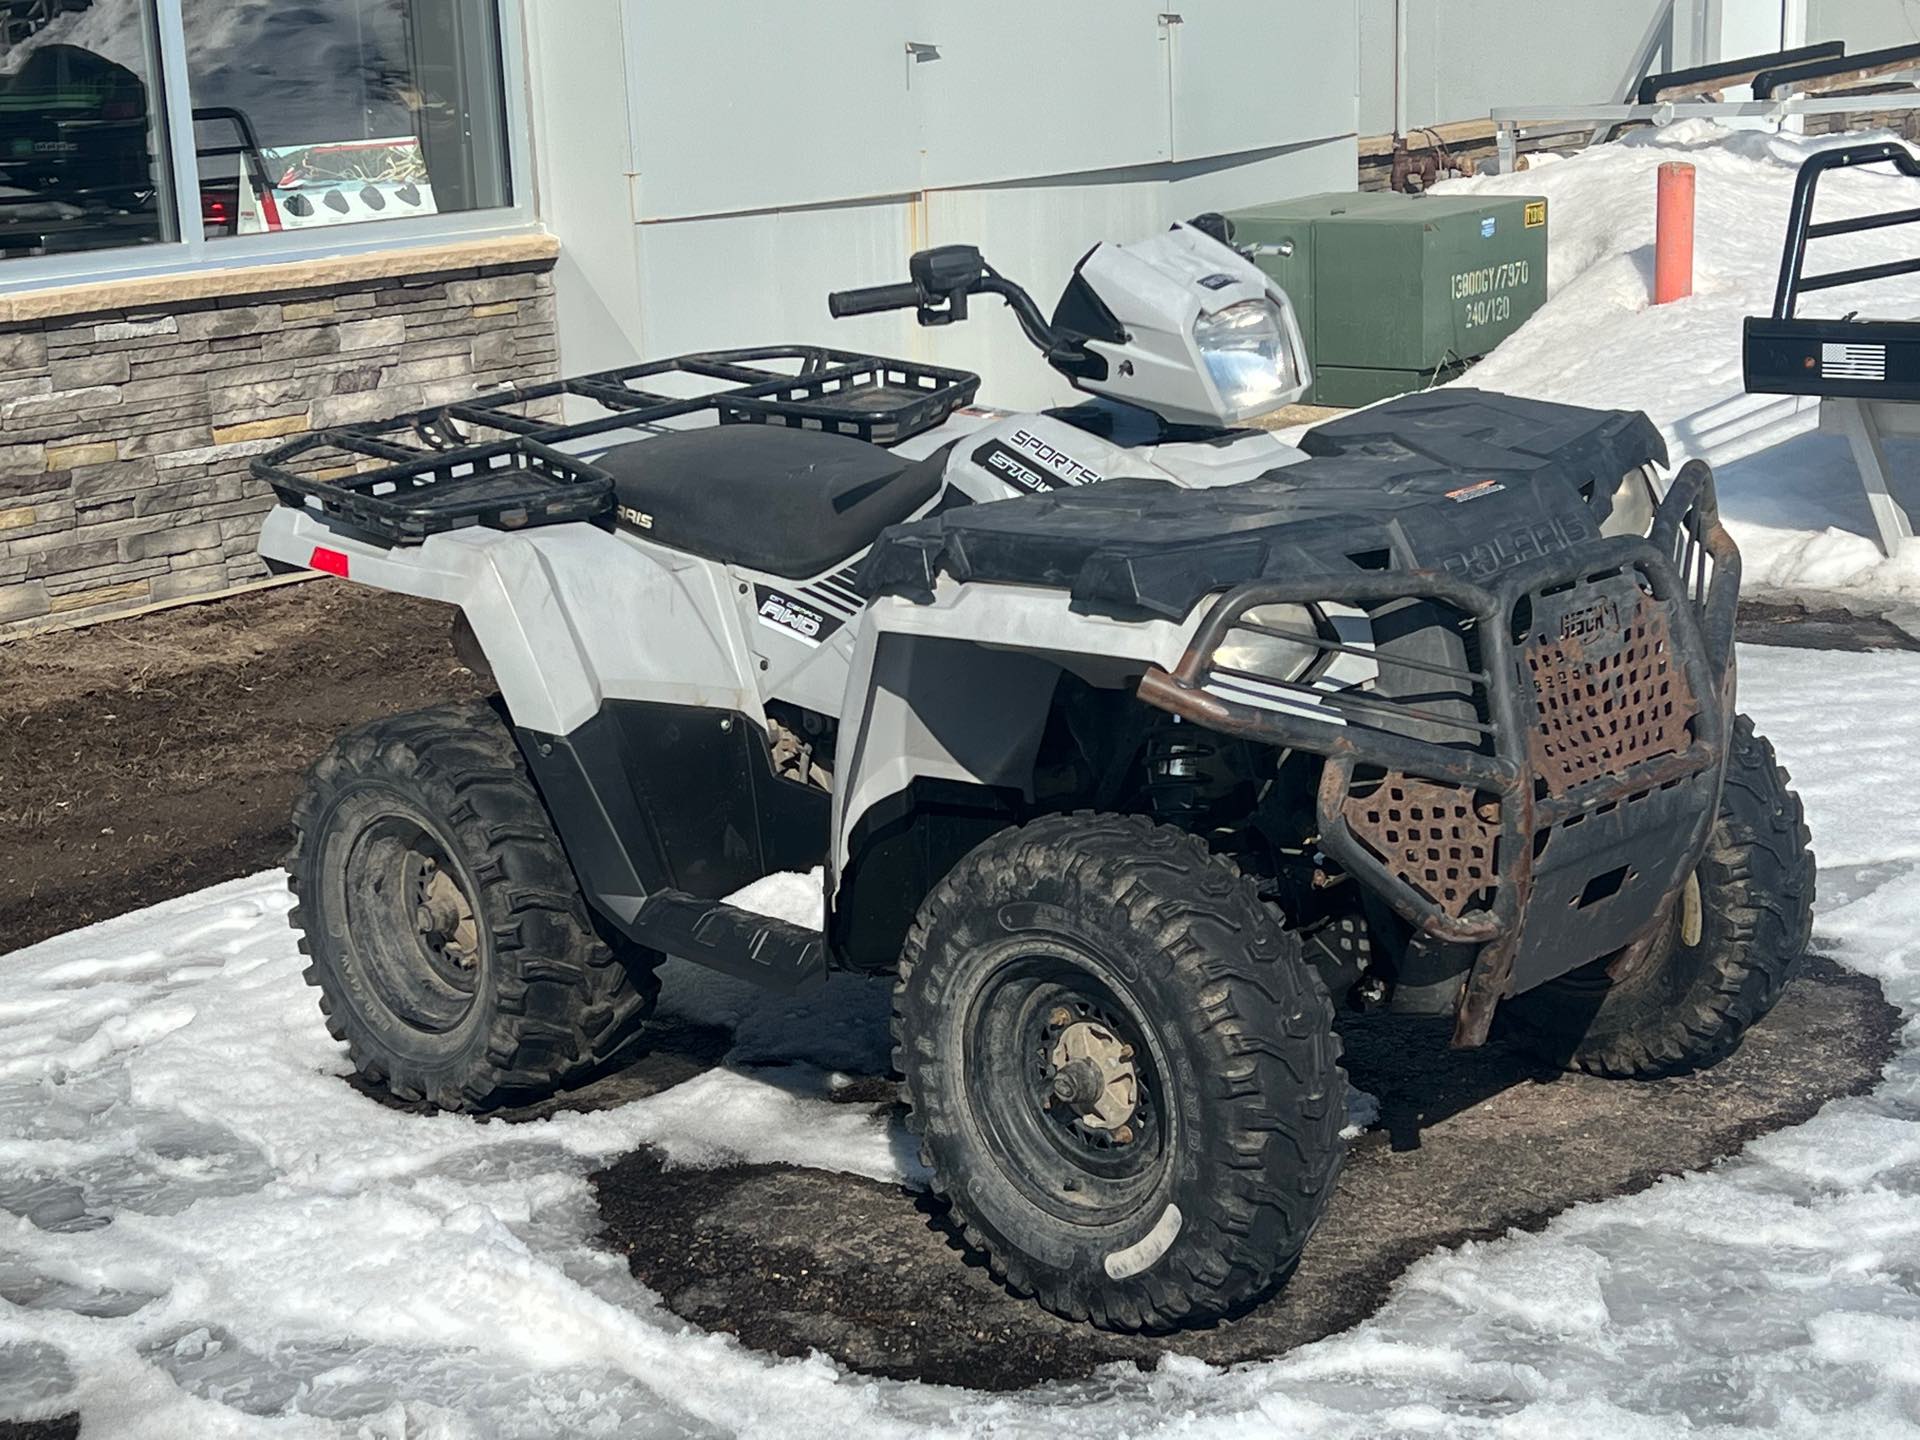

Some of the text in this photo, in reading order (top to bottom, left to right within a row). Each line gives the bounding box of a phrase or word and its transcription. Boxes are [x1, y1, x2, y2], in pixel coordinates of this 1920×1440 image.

[1465, 295, 1510, 328] 240/120
[988, 450, 1043, 489] 570
[1010, 428, 1104, 486] SPORTS
[759, 599, 820, 636] AWD
